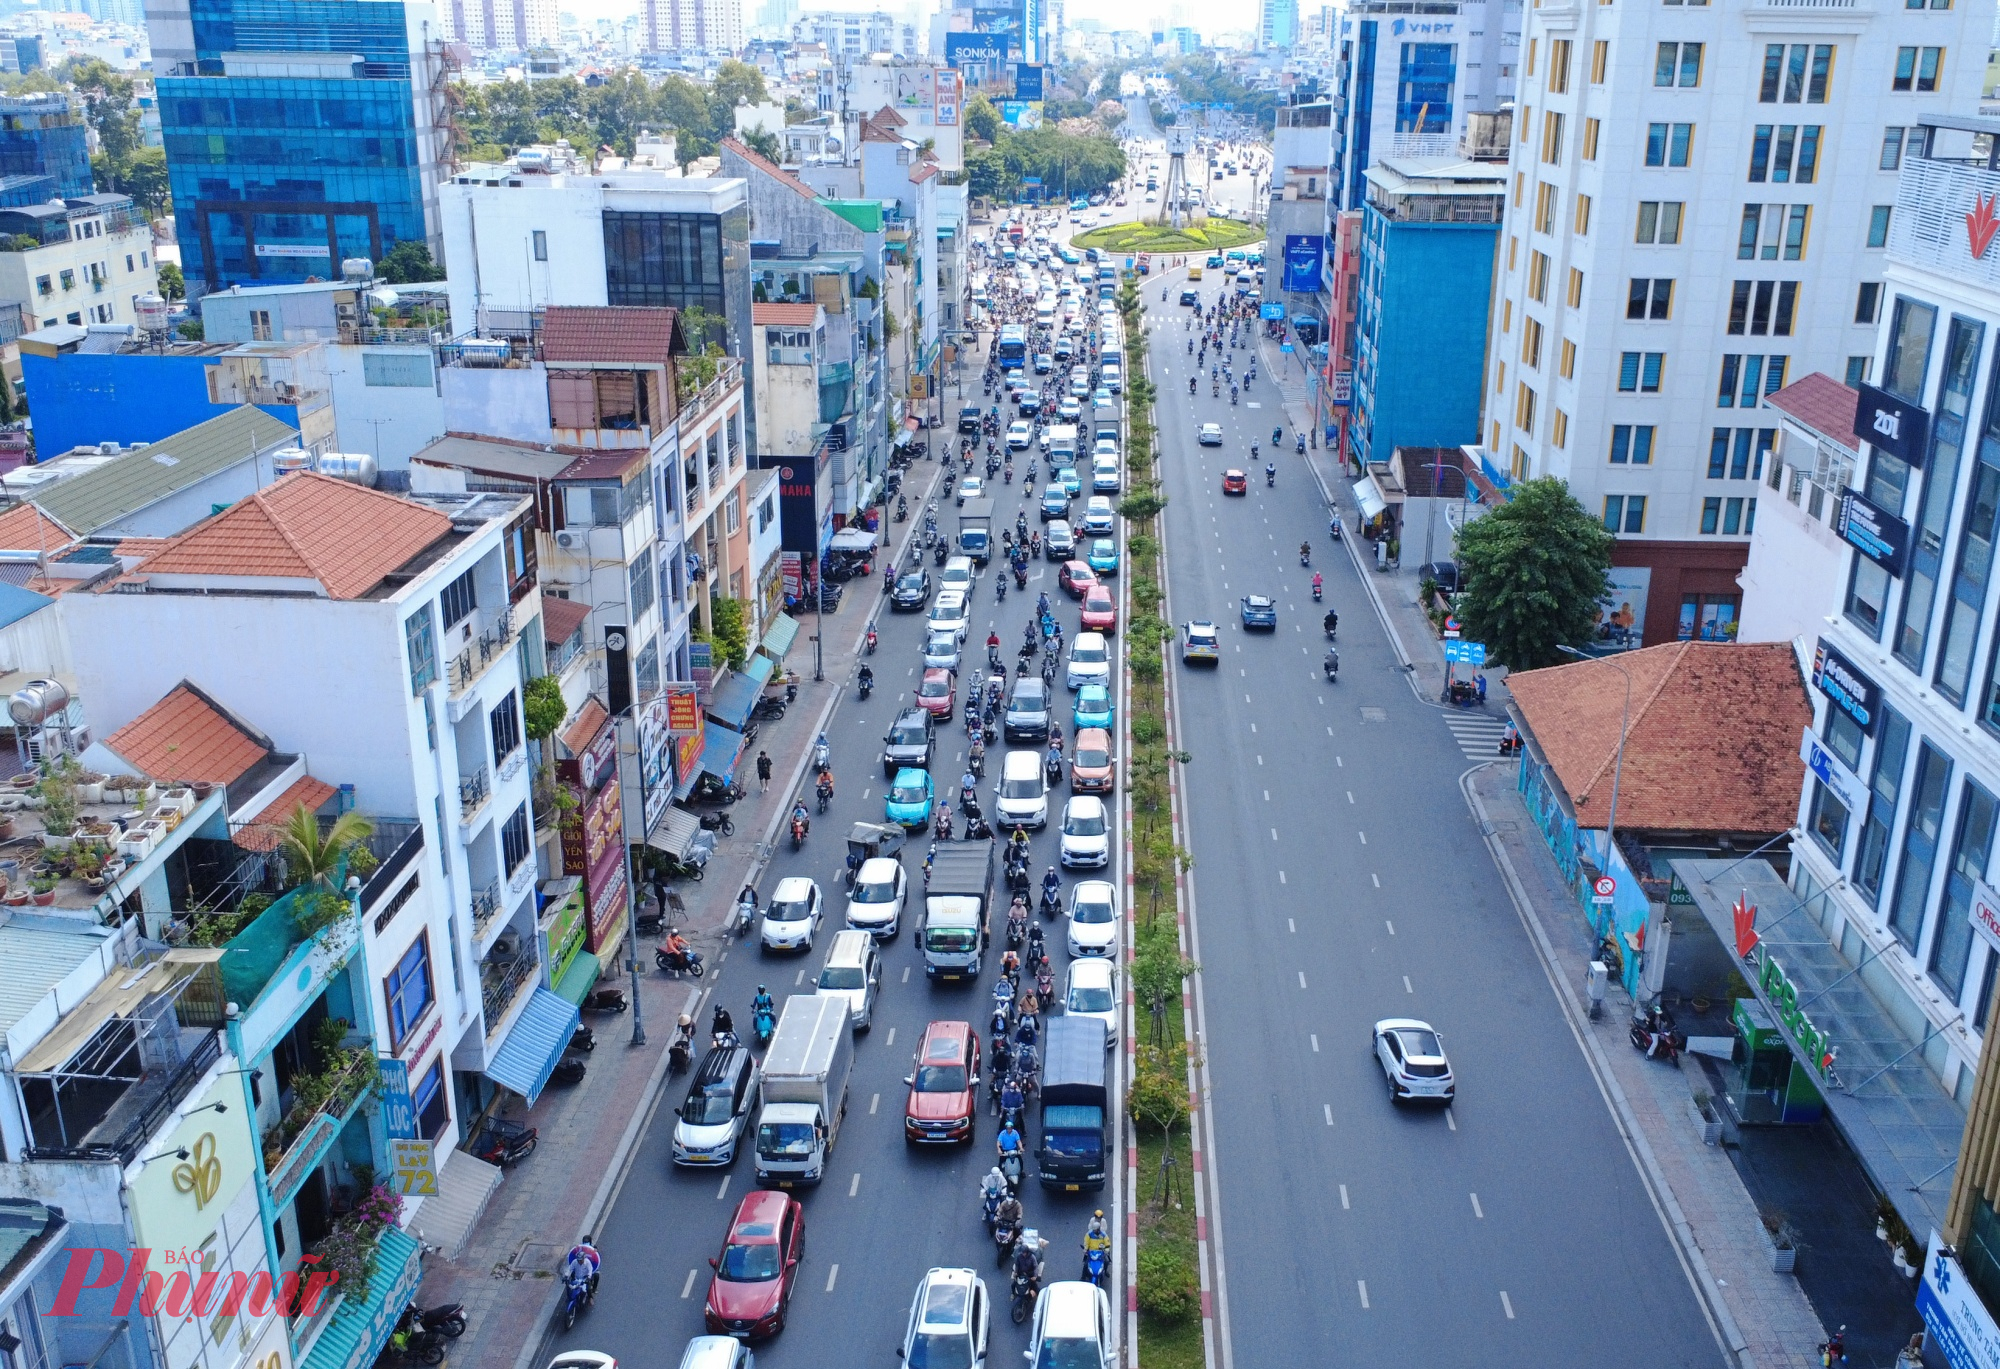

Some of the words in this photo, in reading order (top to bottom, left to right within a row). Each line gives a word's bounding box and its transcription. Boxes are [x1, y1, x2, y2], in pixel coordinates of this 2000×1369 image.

[1410, 23, 1454, 34] VNPT
[955, 47, 1000, 59] SONKIM
[939, 96, 956, 105] ANH
[940, 106, 953, 116] 14
[1873, 409, 1902, 440] zoi
[781, 485, 812, 496] MAHA
[1825, 658, 1867, 703] AI-DRIVEN
[1822, 674, 1870, 726] PEOPLE-LED
[381, 1061, 407, 1096] PHỞ
[386, 1098, 410, 1138] LỘC
[399, 1155, 429, 1167] L&V
[398, 1169, 437, 1194] 72
[1961, 1299, 1983, 1342] TRUNG
[1984, 1336, 2000, 1368] TÂM
